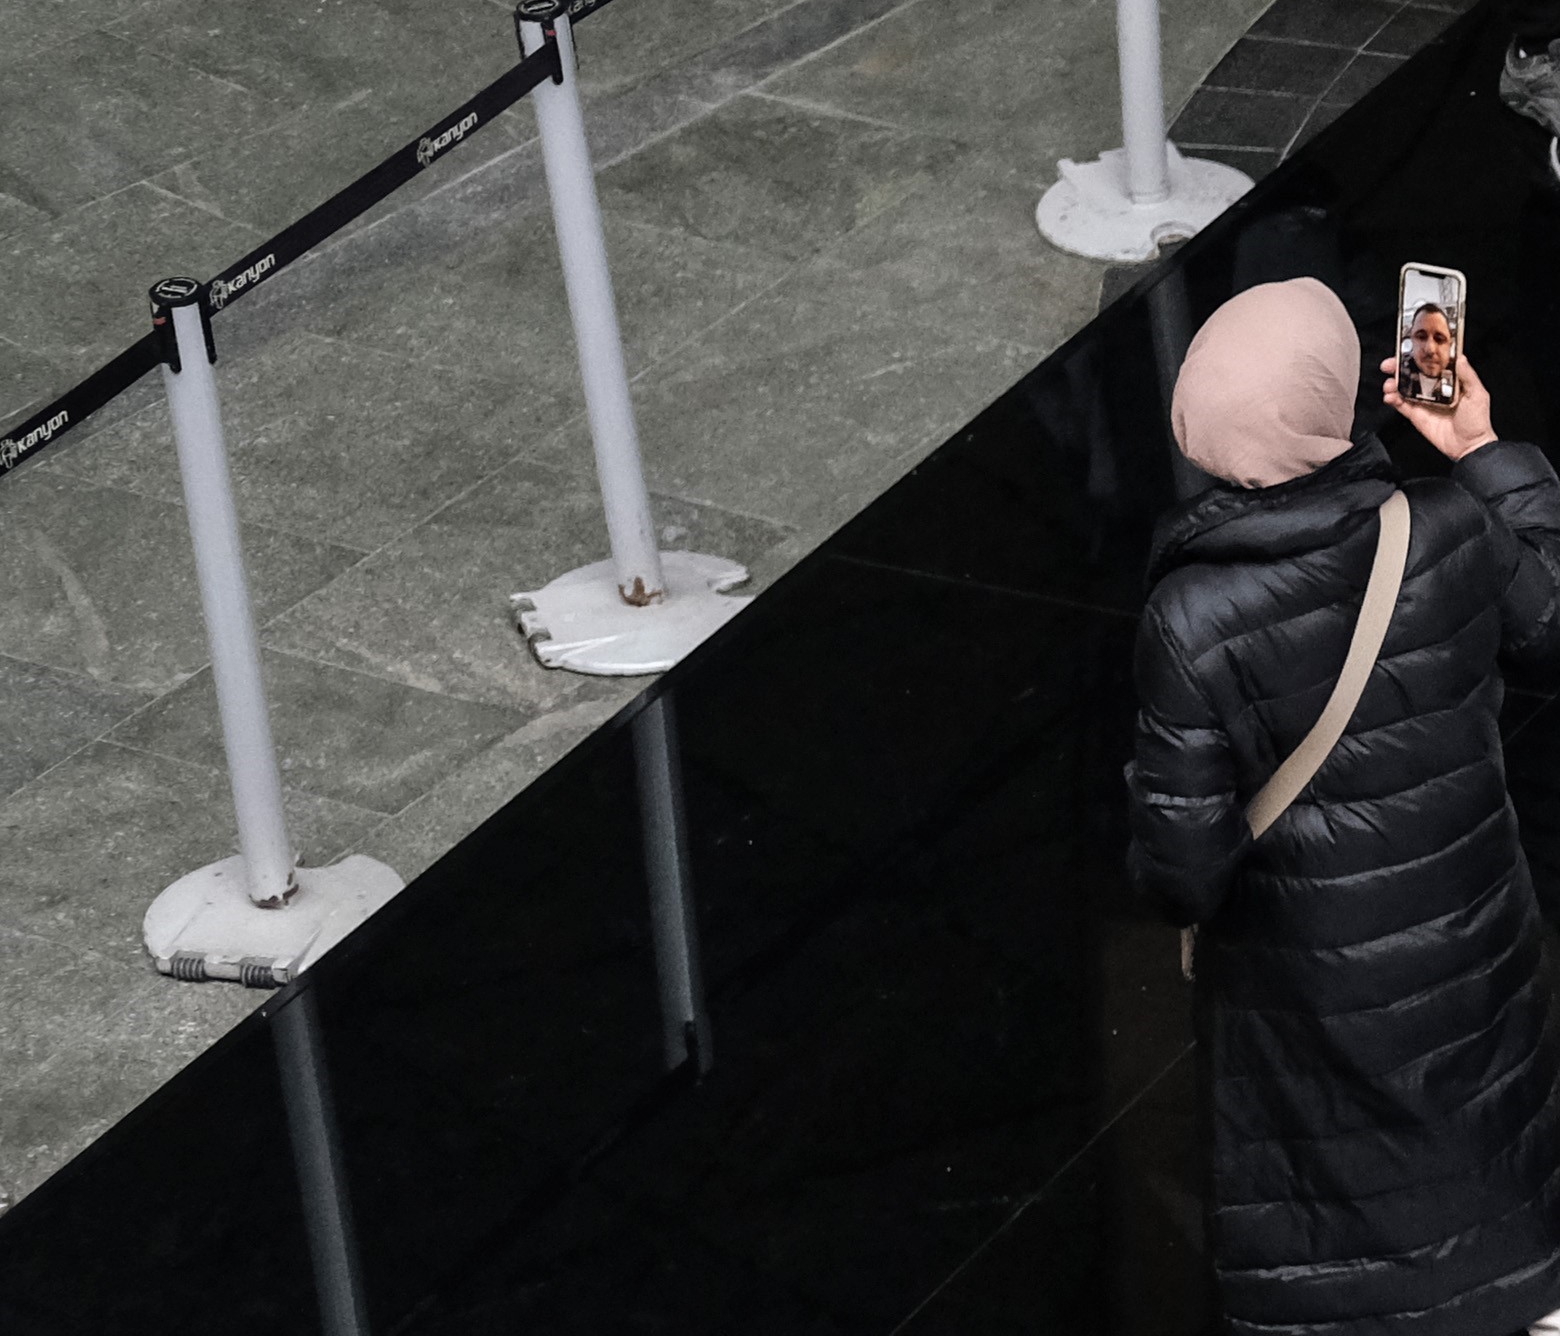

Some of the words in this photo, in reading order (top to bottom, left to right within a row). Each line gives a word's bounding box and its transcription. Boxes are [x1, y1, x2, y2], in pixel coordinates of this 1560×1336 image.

[433, 112, 478, 151] kanyon
[228, 253, 275, 294] kanyon
[18, 410, 69, 453] kanyon
